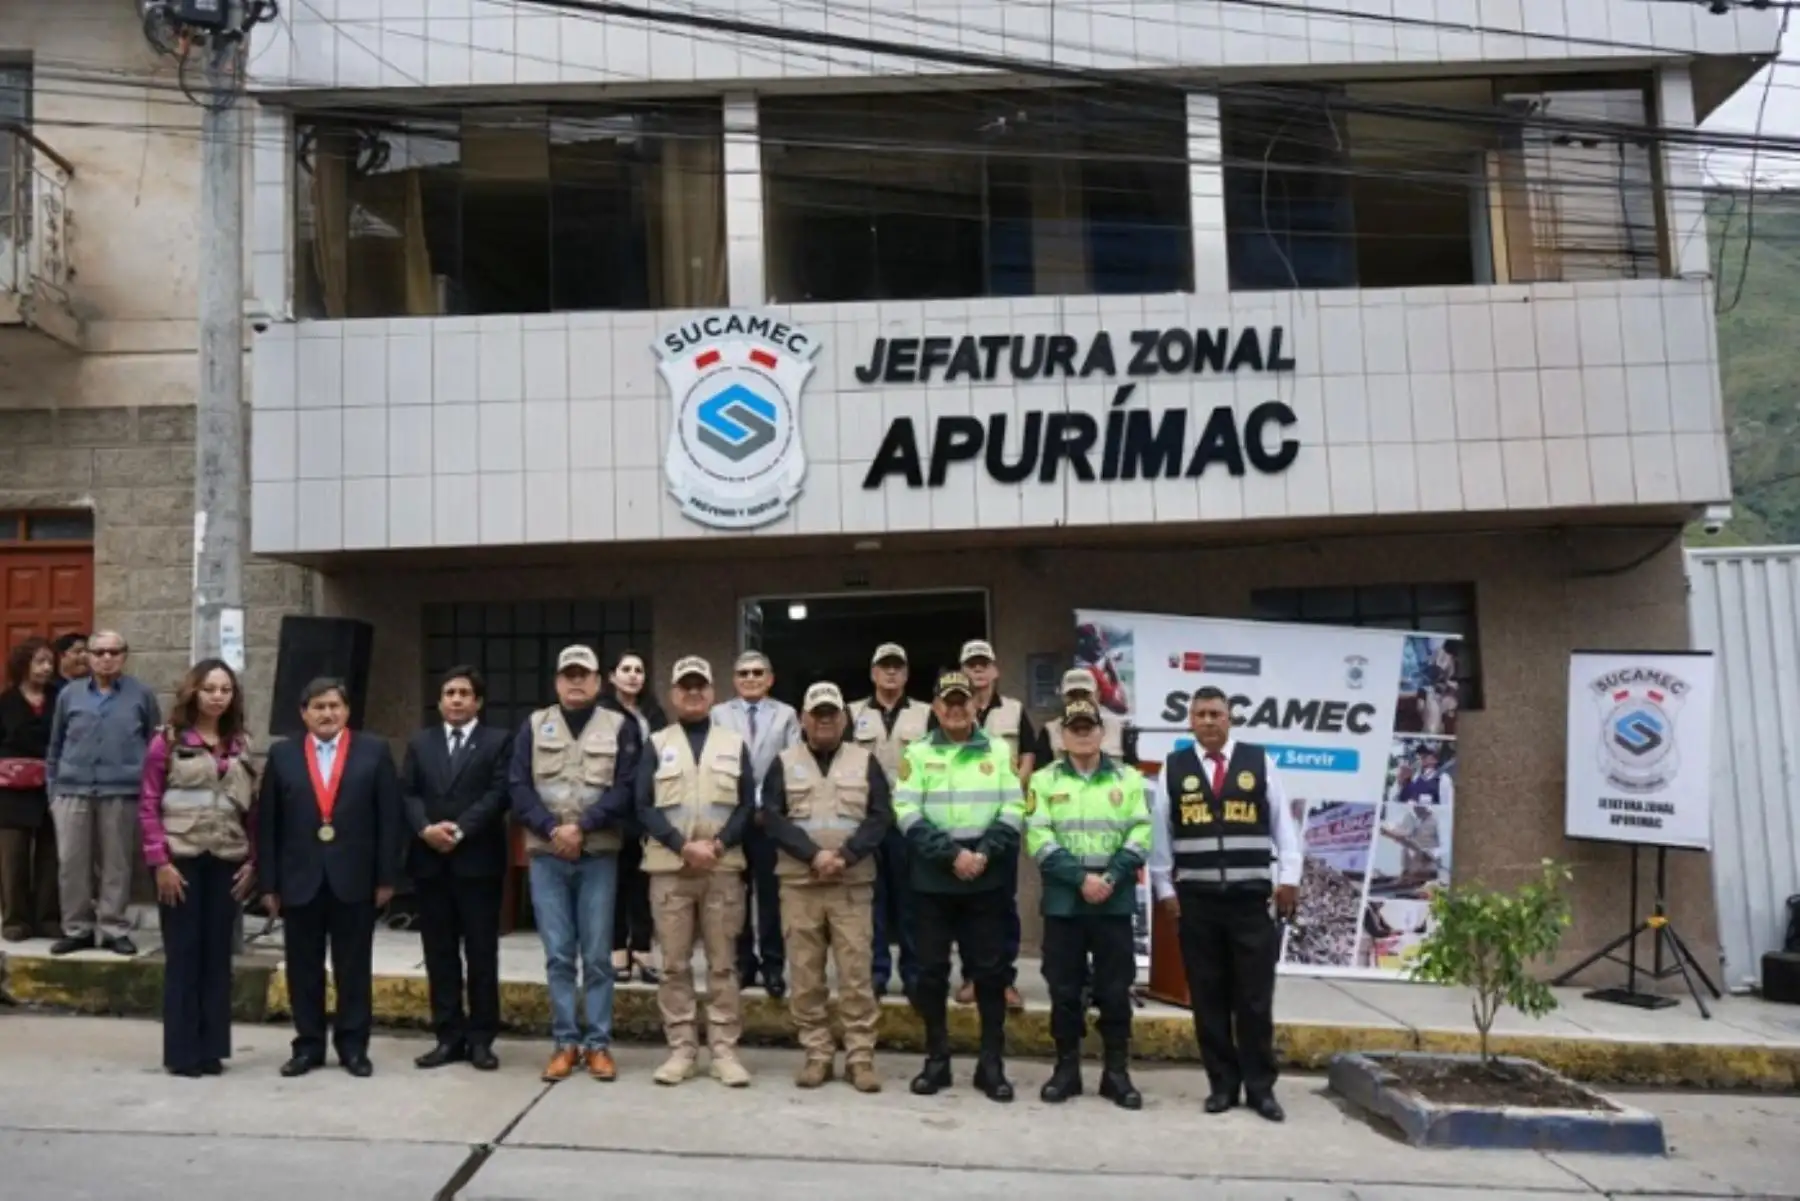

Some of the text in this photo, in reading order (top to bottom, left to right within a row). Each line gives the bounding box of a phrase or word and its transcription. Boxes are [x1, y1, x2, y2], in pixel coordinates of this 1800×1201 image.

[664, 314, 808, 355] SUCAMEC
[855, 325, 1296, 384] JEFATURA ZONAL
[862, 384, 1300, 489] APURÍMAC
[1596, 669, 1685, 695] SUCAMEC
[1160, 690, 1377, 735] SCAMEC
[1285, 749, 1336, 767] Servir
